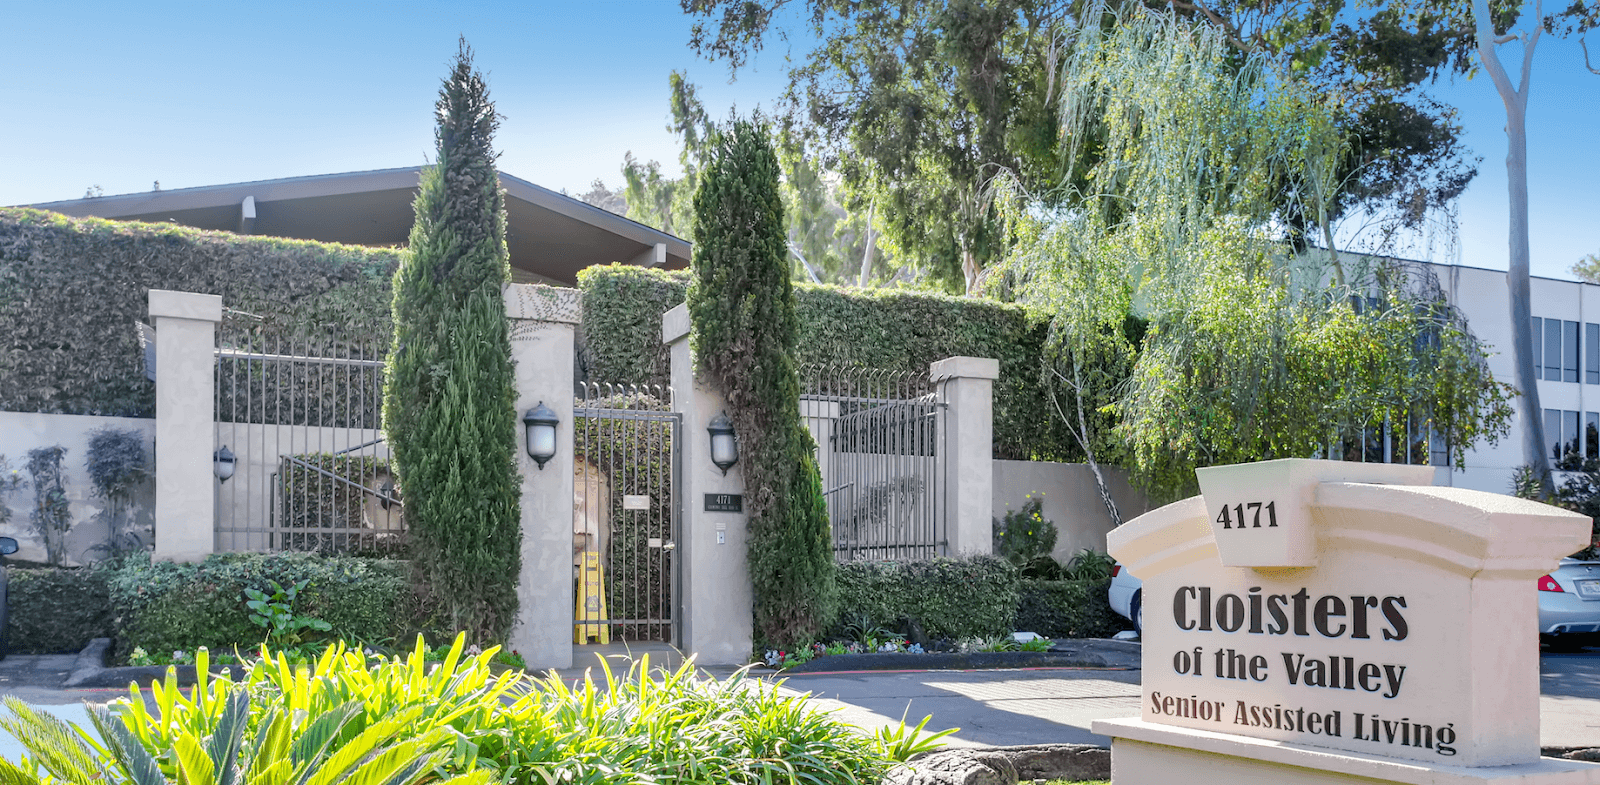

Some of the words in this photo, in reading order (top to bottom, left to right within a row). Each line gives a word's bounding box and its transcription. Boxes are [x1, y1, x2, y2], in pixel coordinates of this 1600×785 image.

[716, 495, 731, 504] 4171
[1216, 501, 1279, 530] 4171
[1173, 586, 1409, 642] Cloisters
[1173, 646, 1203, 676] of
[1214, 648, 1268, 682] the
[1281, 652, 1407, 699] Valley
[1150, 691, 1226, 722] Senior
[1233, 700, 1342, 738] Assisted
[1353, 712, 1458, 756] Living
